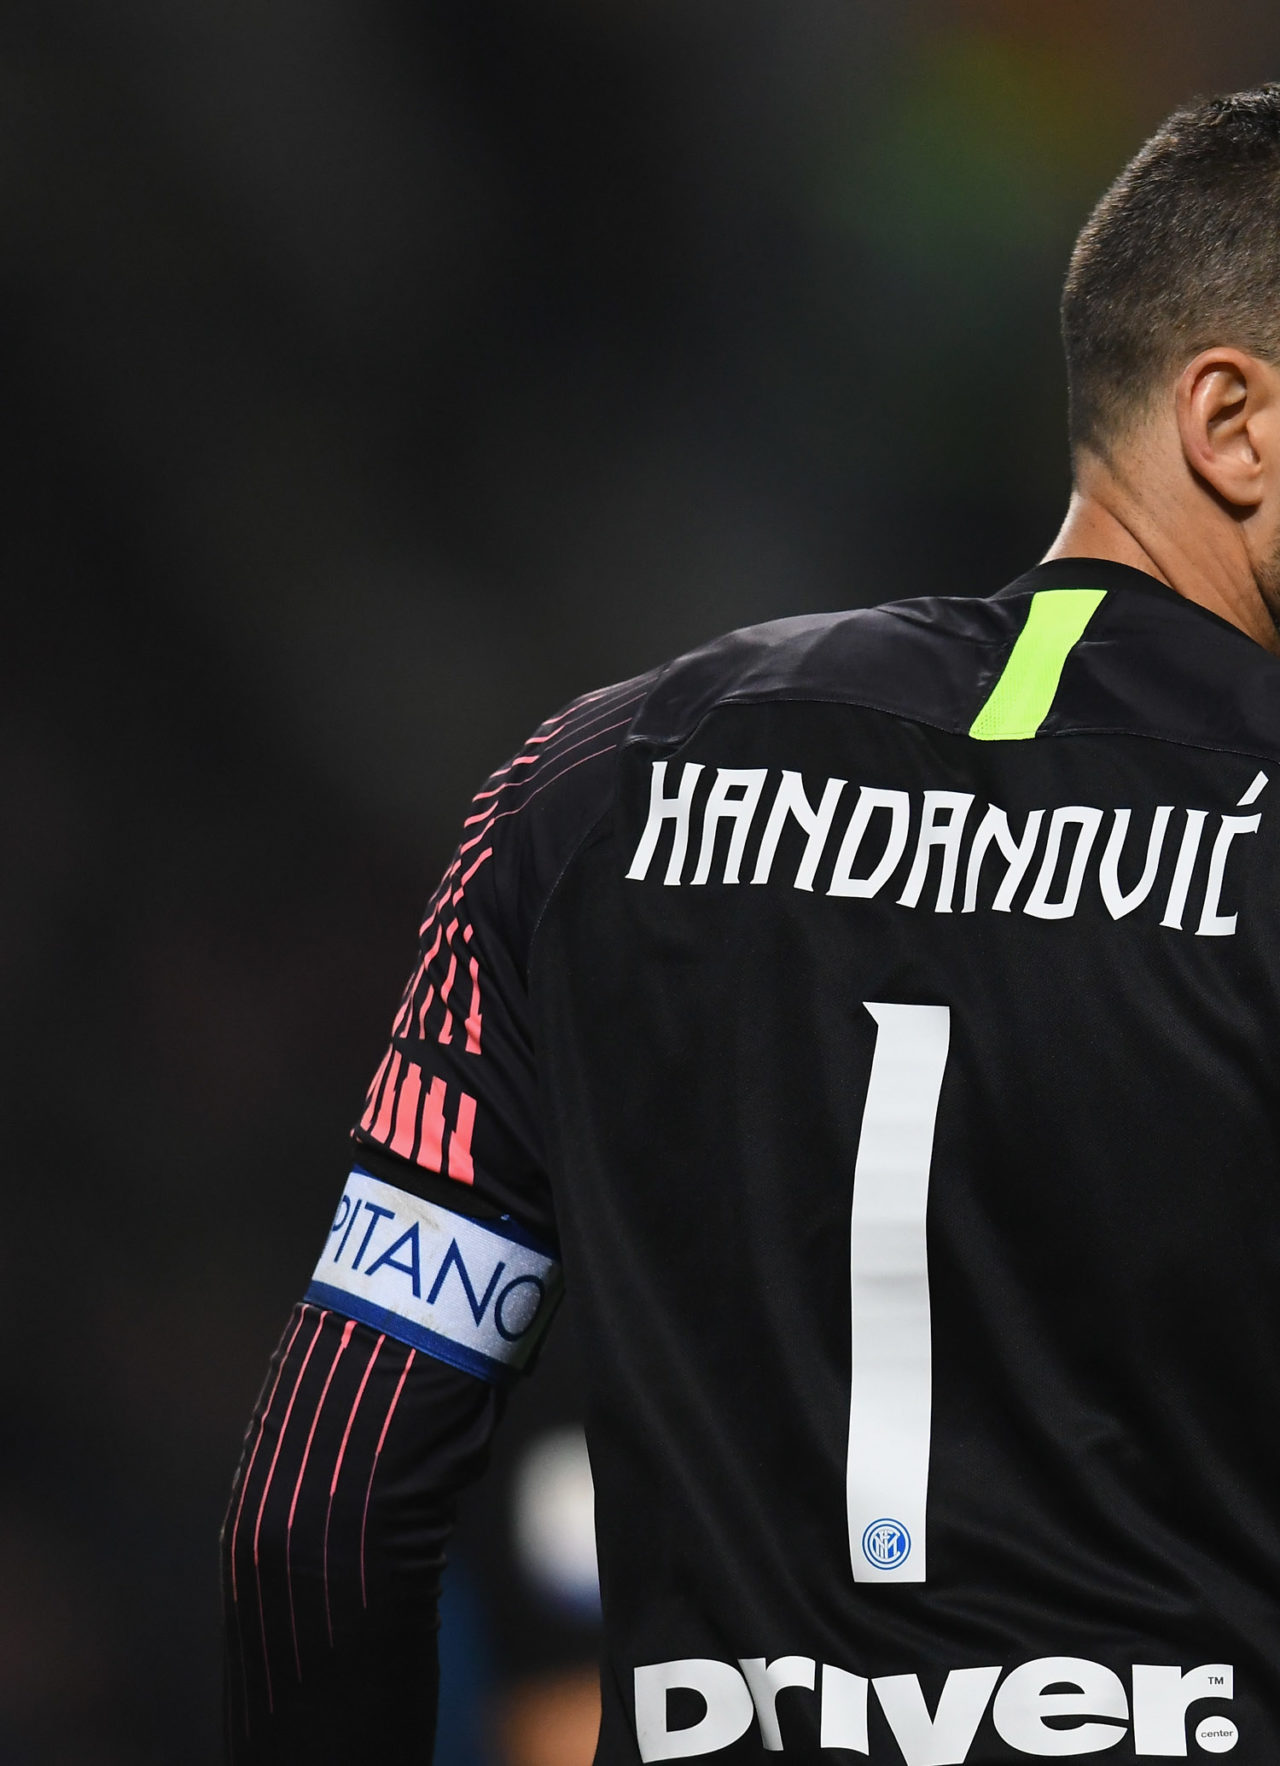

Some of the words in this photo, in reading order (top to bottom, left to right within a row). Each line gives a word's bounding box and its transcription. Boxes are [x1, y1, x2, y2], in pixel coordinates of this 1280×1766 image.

[624, 761, 1269, 937] HANDANOVIĆ
[847, 1002, 951, 1583] 1
[1207, 1676, 1224, 1685] TM
[1200, 1729, 1234, 1738] center
